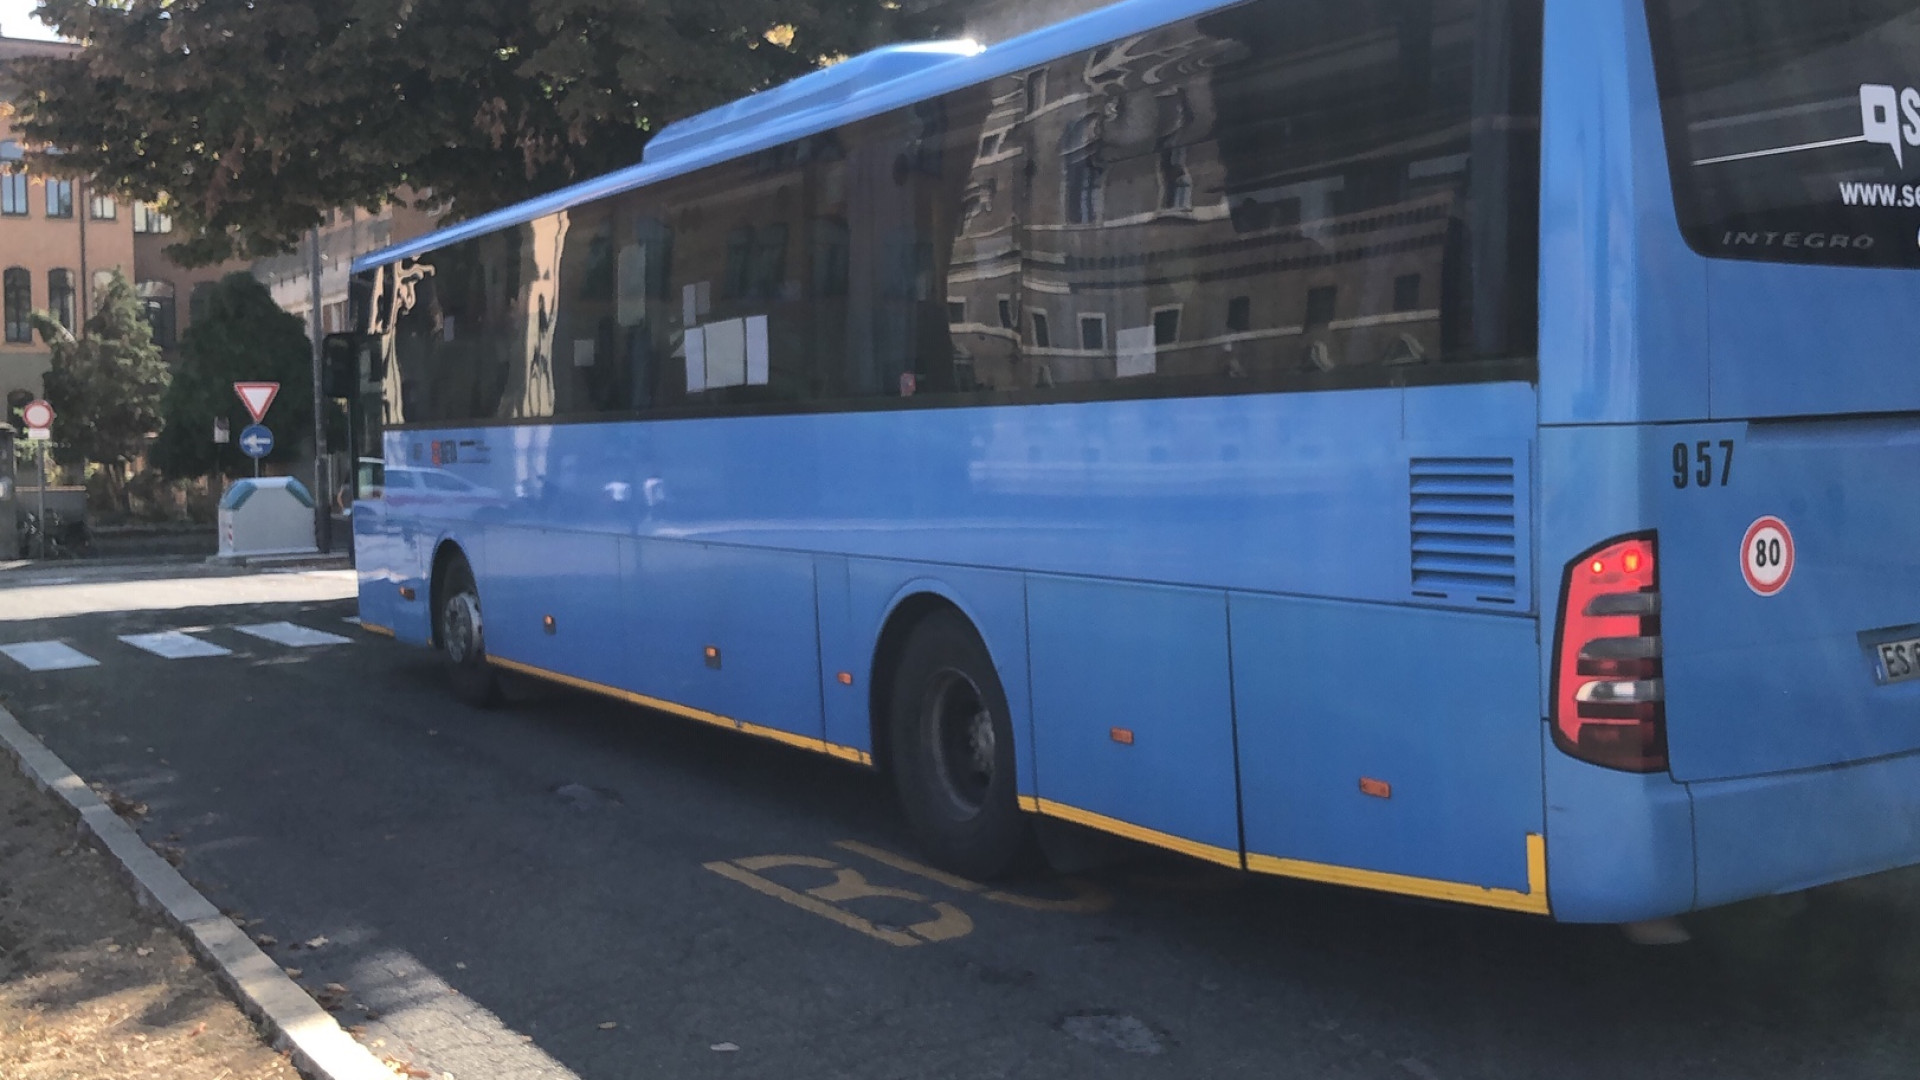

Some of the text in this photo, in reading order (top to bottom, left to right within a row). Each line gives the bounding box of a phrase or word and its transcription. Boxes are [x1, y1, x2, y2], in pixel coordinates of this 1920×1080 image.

[1722, 231, 1874, 249] INTEGRO
[1672, 439, 1733, 489] 957
[1755, 538, 1780, 567] 80
[702, 839, 1115, 947] BU
